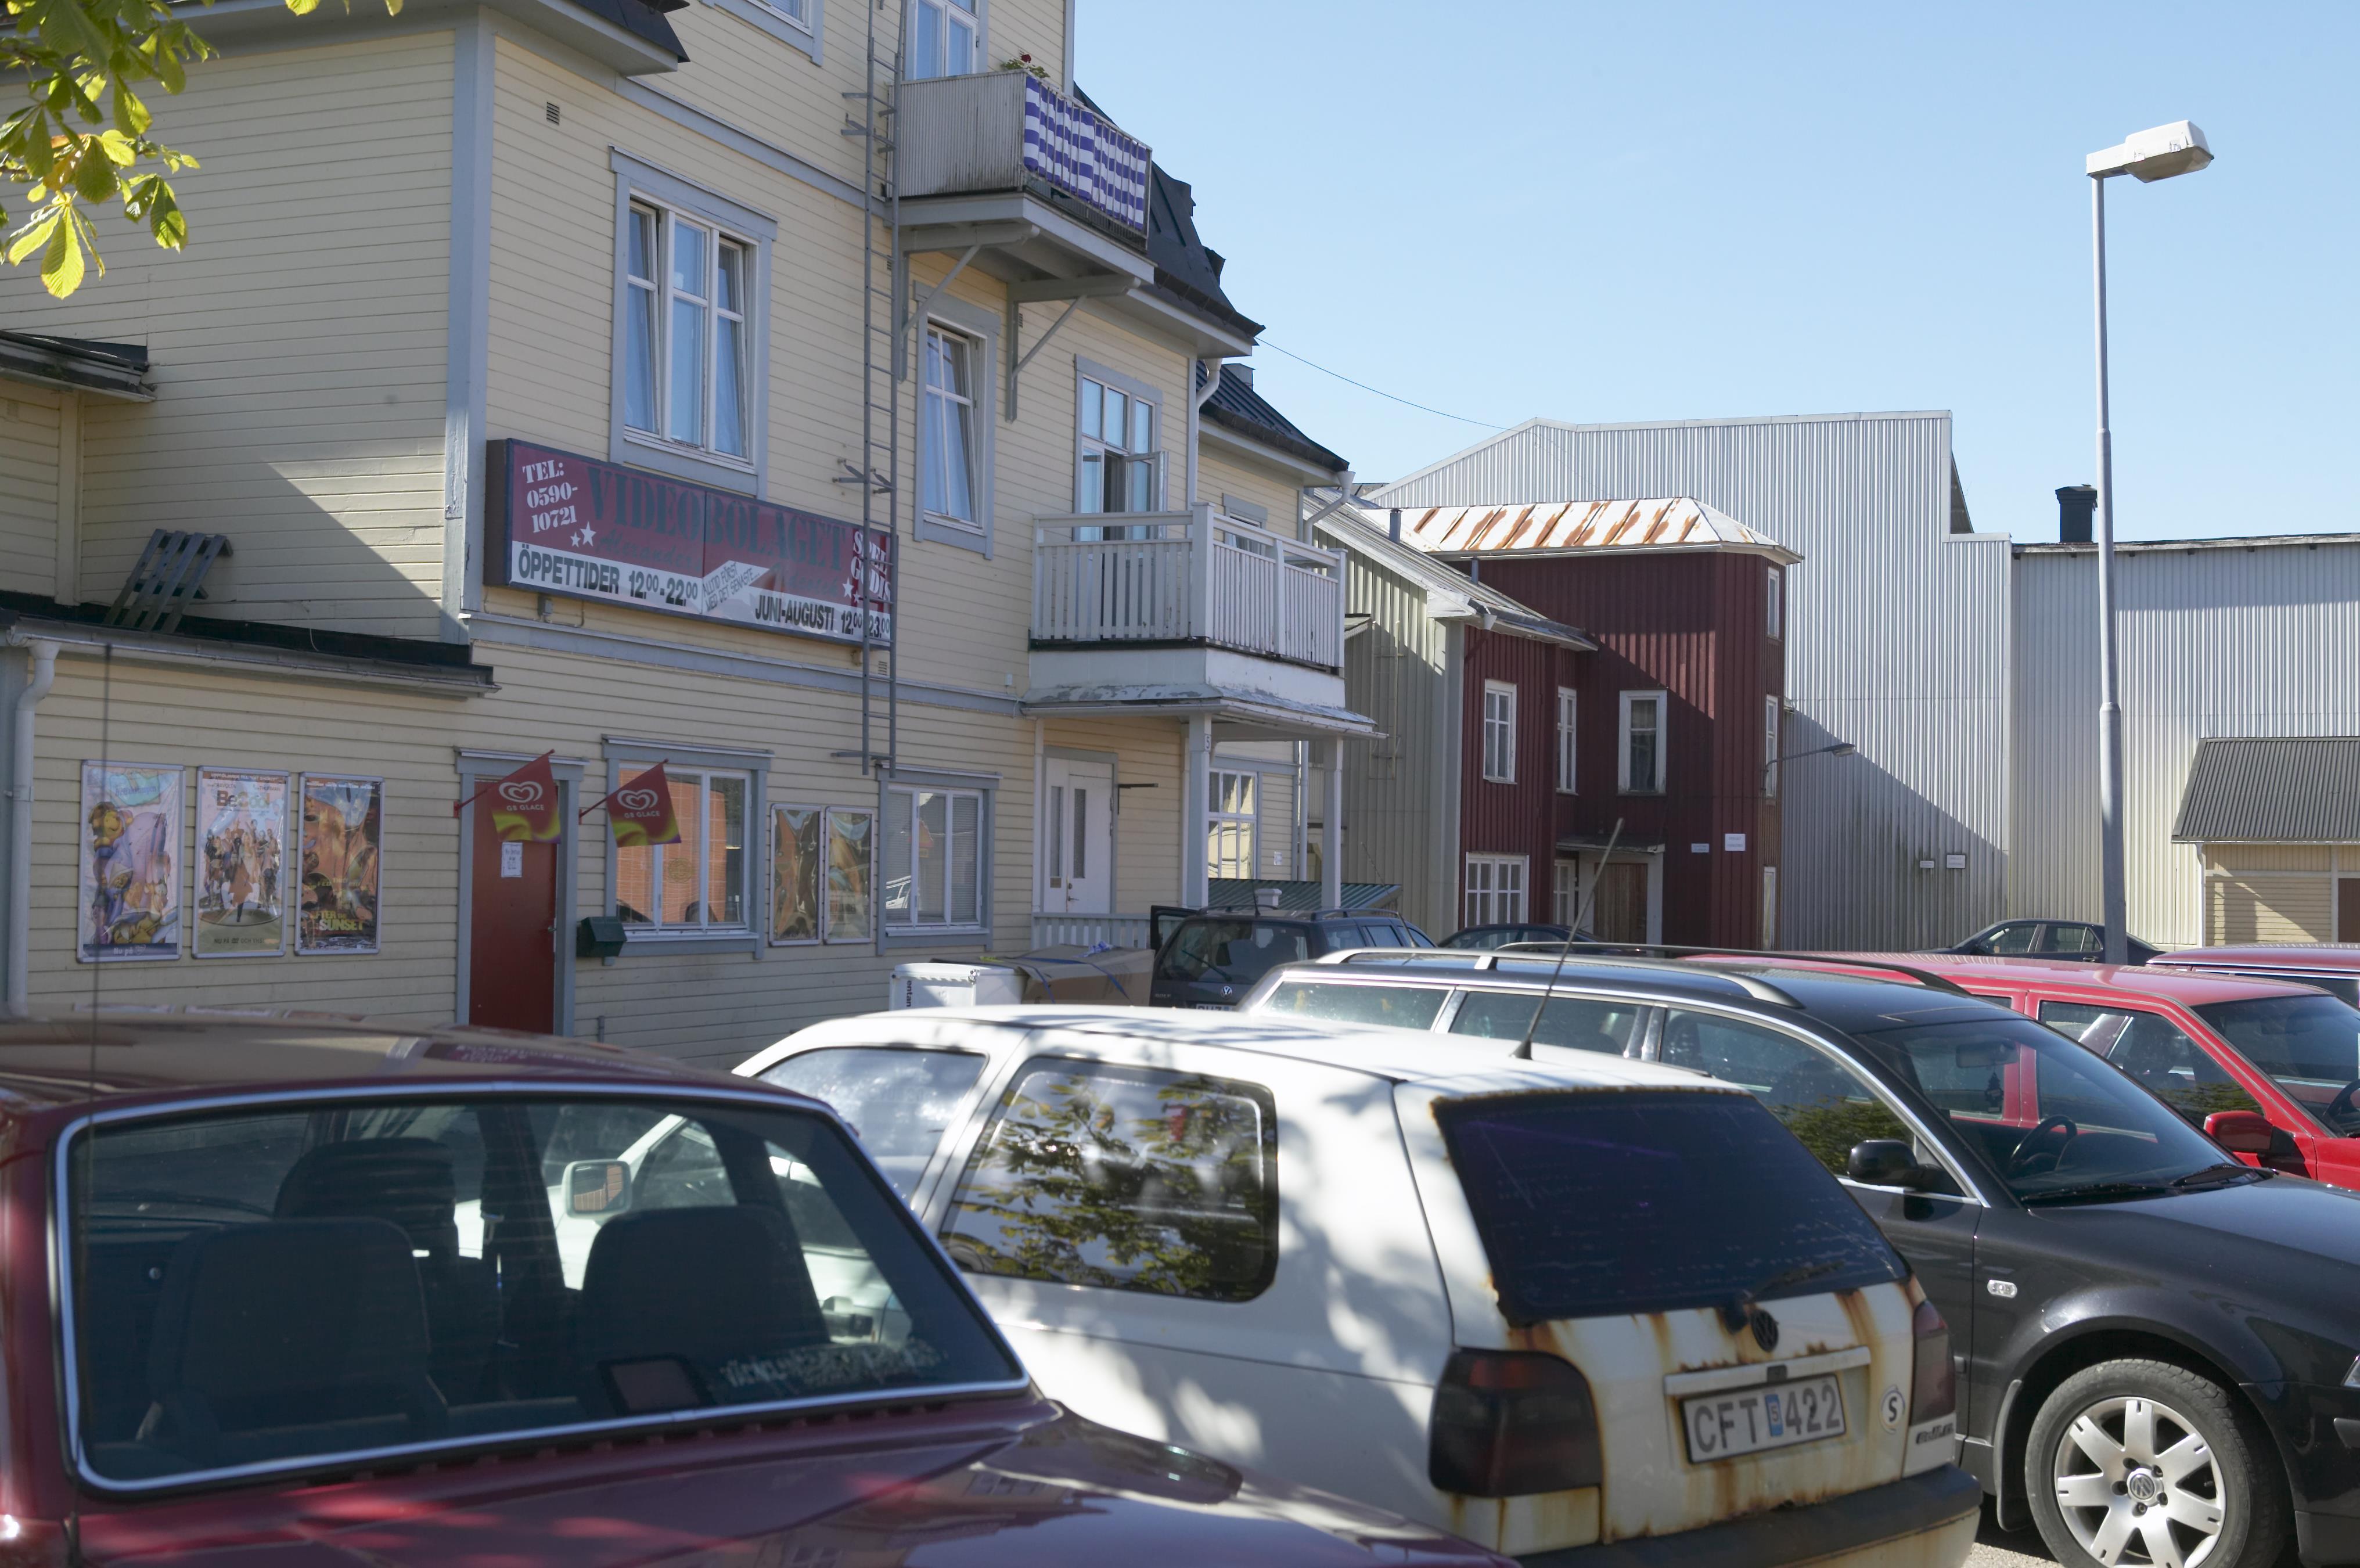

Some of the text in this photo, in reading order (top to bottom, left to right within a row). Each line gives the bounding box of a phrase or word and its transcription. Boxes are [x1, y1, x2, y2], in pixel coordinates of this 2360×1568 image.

[522, 459, 564, 483] TEL:
[527, 482, 578, 509] 0590-
[532, 505, 577, 533] 10721
[587, 466, 846, 571] VIDEOBOLAGET
[852, 531, 886, 576] SEL
[518, 544, 620, 595] ÖPPETTIDER
[719, 584, 730, 603] DET
[755, 595, 834, 631] JUNI-AUGUSTI
[319, 919, 363, 931] SUNSET
[125, 947, 134, 956] på
[1695, 1398, 1758, 1453] CFT
[1785, 1384, 1840, 1436] 422
[1887, 1396, 1898, 1422] S
